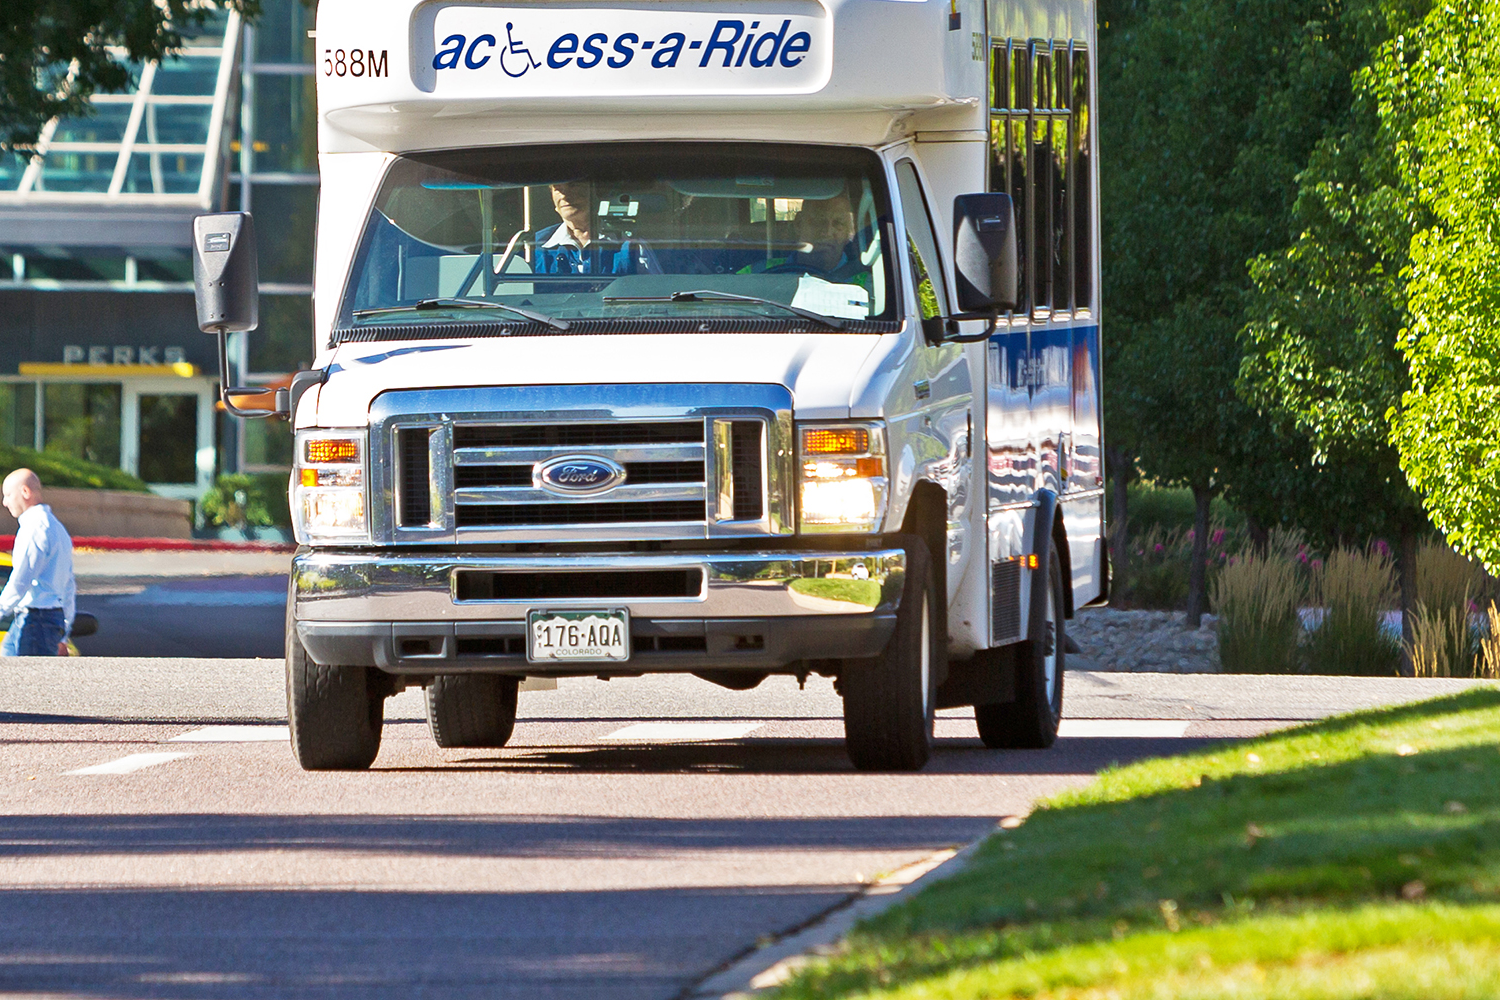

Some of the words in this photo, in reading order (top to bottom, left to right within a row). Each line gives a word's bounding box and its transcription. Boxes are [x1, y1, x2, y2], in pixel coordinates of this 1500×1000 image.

[324, 48, 389, 77] 588M
[63, 344, 186, 366] PERKS
[558, 465, 598, 482] Ford
[555, 648, 602, 656] COLORADO
